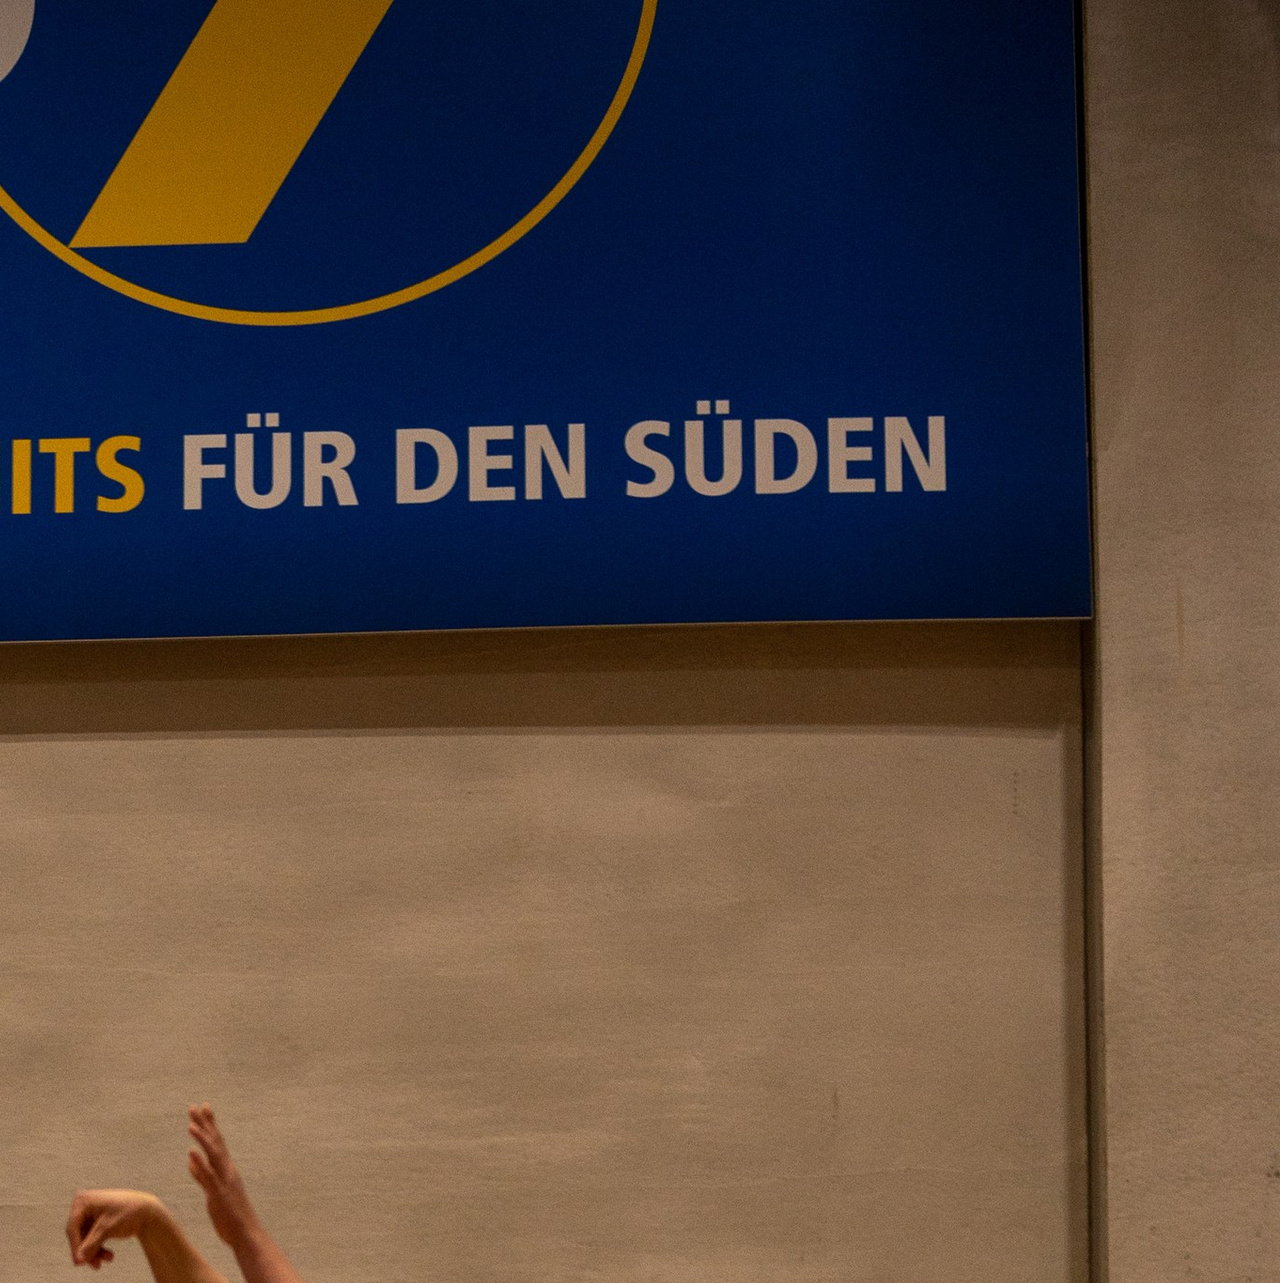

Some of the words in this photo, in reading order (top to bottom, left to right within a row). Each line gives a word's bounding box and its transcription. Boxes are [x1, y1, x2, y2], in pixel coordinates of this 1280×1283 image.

[184, 413, 358, 510] FÜR
[396, 424, 585, 504] DEN
[625, 400, 946, 497] SÜDEN
